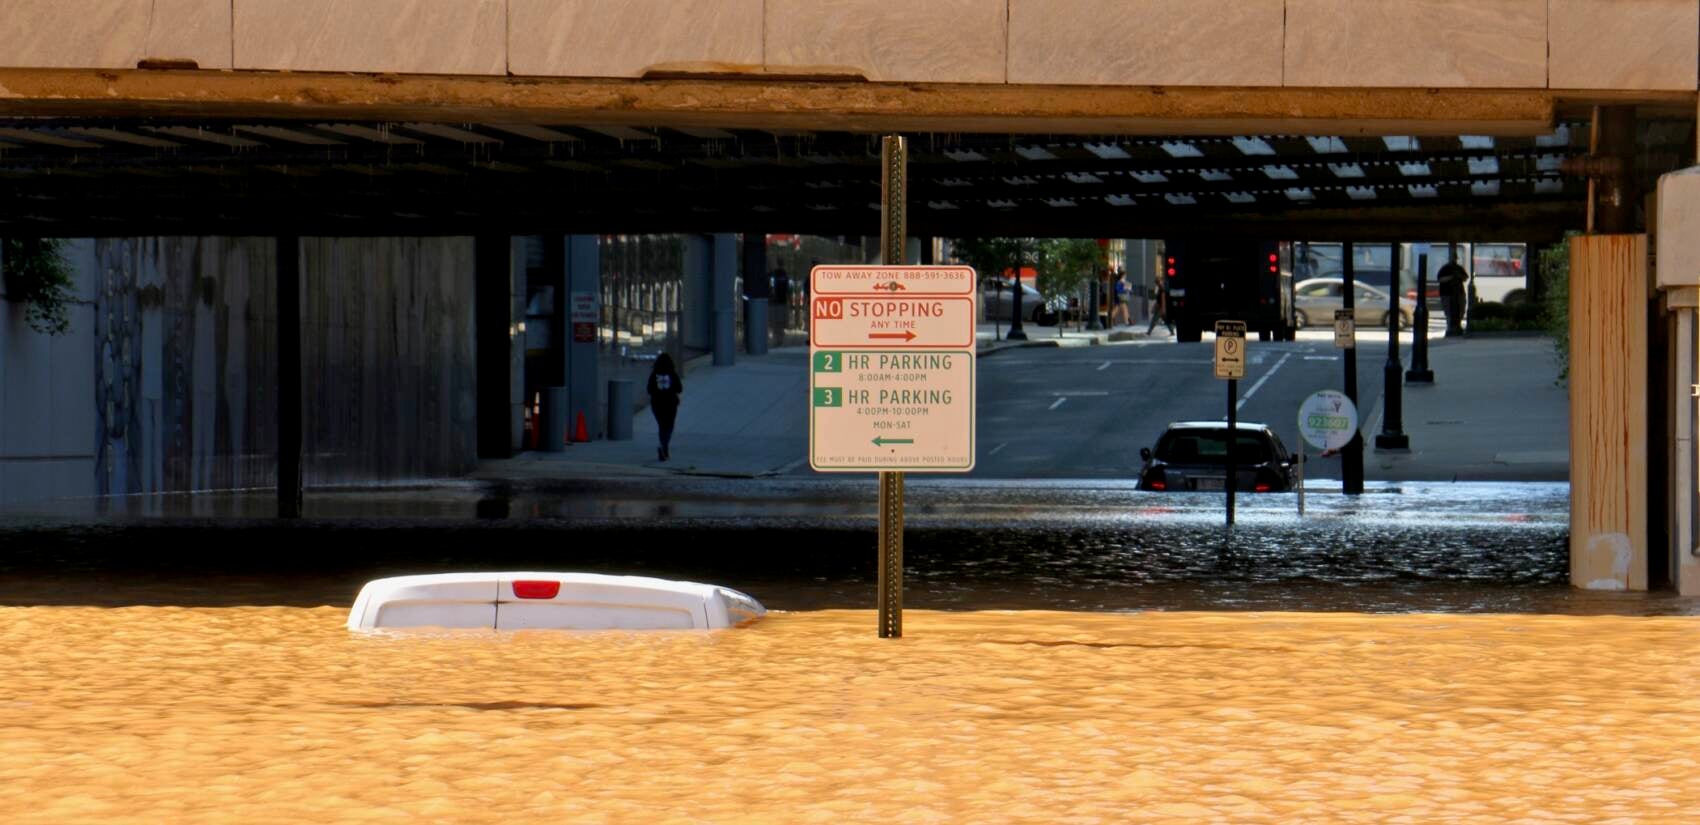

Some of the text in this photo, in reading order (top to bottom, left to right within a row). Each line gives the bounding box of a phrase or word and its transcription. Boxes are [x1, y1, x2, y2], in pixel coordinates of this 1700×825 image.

[822, 271, 965, 280] TOW AWAY ZONE 888-591-3636
[816, 302, 944, 317] NO STOPPING
[870, 320, 916, 329] ANY TIME
[823, 354, 953, 370] 2 HR PARKING
[858, 373, 928, 382] 8:00AM-4:00PM
[823, 389, 953, 405] 3 HR PARKING
[856, 407, 929, 416] 4:00PM-10:00PM
[873, 421, 911, 430] MON-SAT
